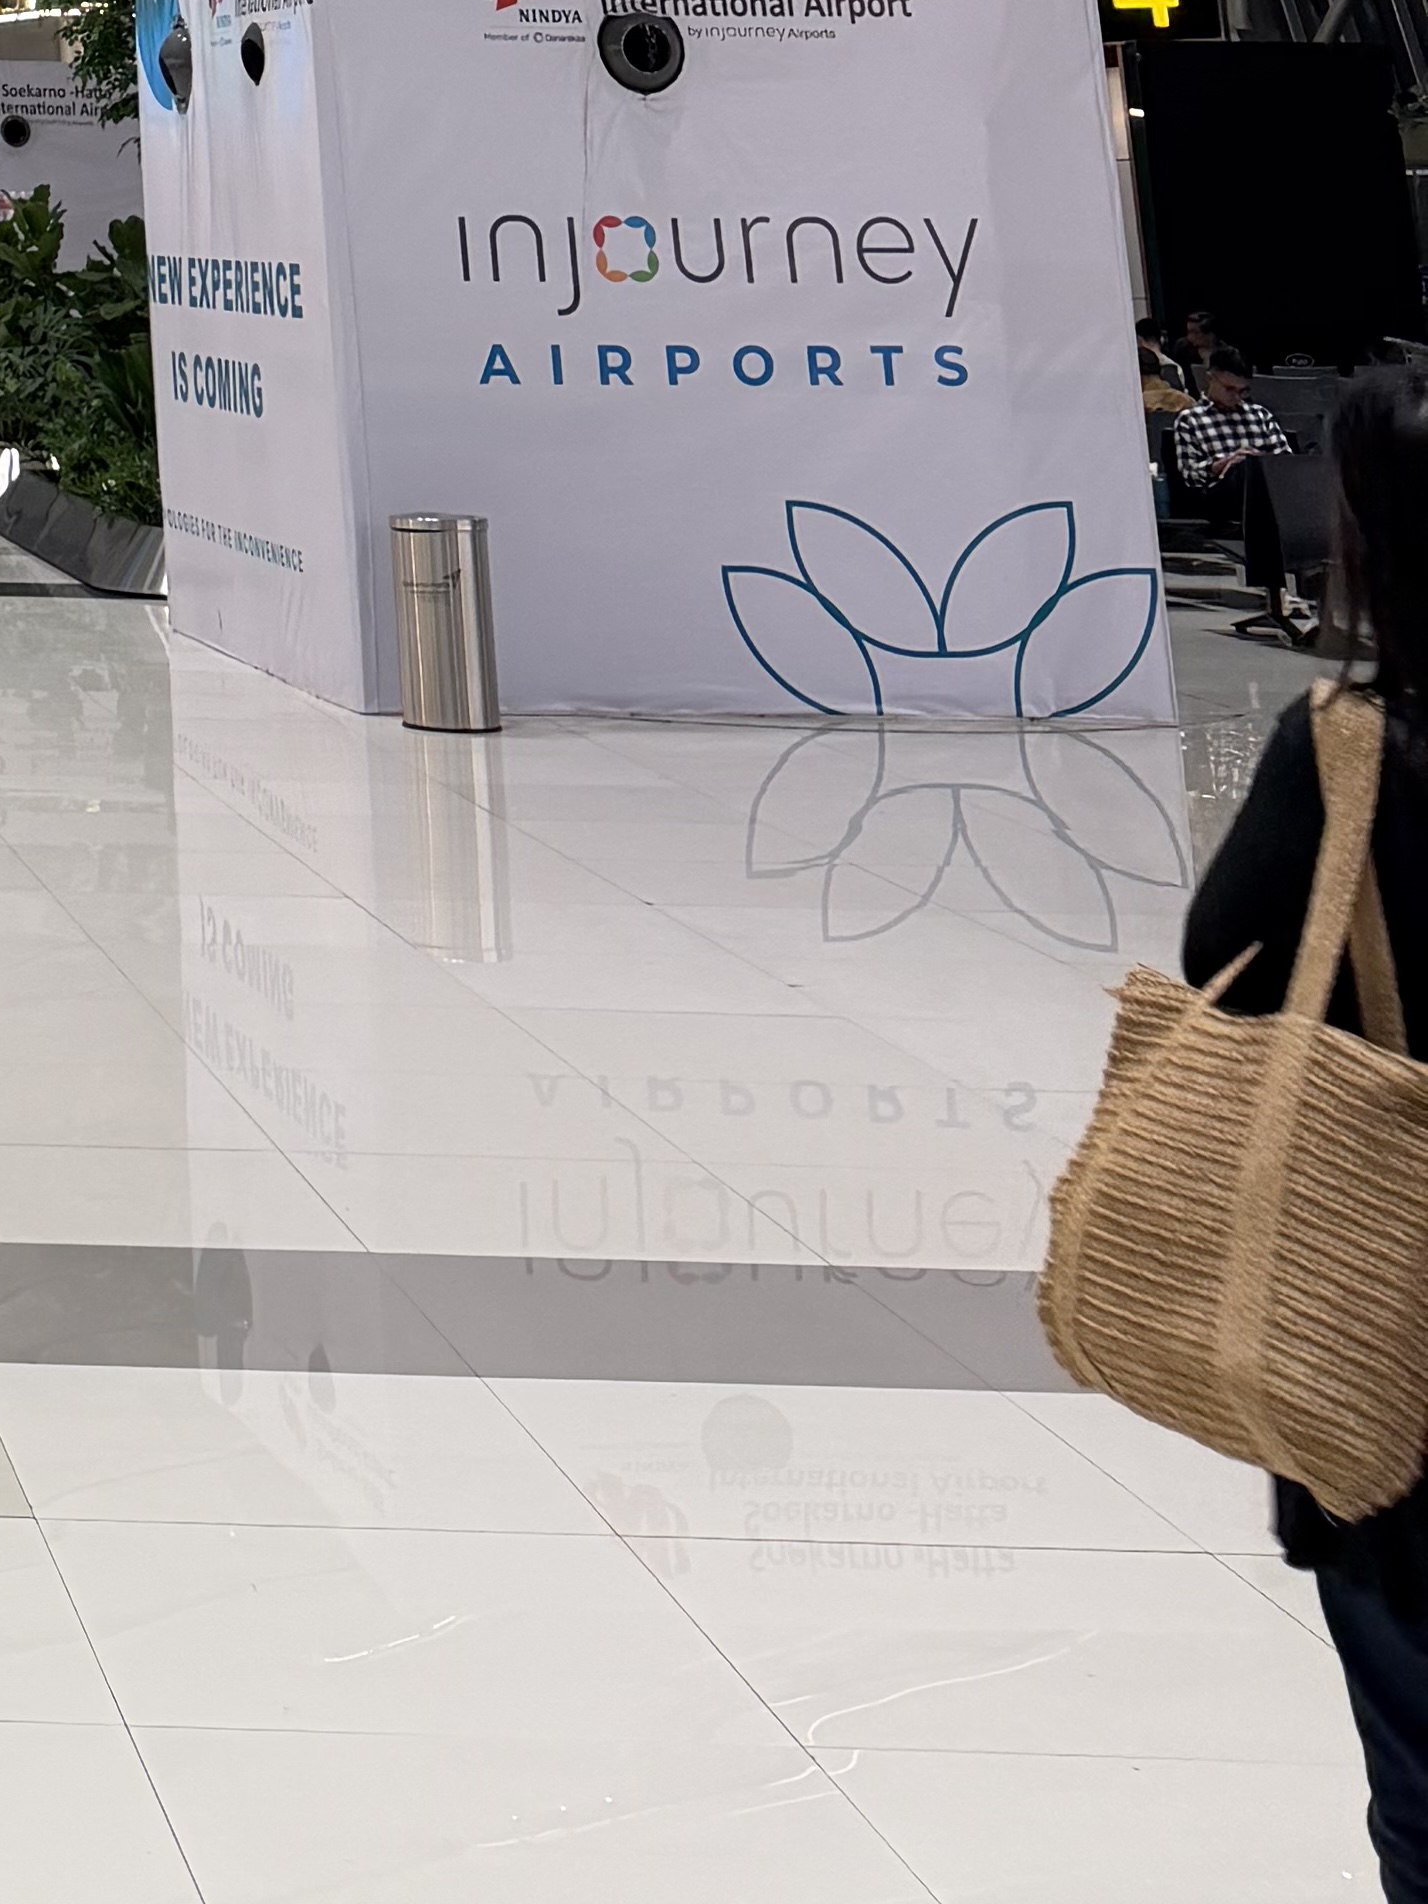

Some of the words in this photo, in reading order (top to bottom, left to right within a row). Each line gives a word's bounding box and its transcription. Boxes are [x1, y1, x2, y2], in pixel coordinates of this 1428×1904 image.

[483, 32, 519, 42] Member
[520, 33, 530, 42] of
[518, 8, 583, 24] NINDYA
[687, 25, 702, 39] by
[787, 27, 836, 41] Airports
[1, 83, 67, 99] Soekarno
[148, 254, 183, 306] NEW
[188, 256, 304, 319] EXPERIENCE
[457, 213, 979, 318] injourney
[171, 350, 189, 403] IS
[193, 353, 264, 419] COMING
[478, 343, 970, 387] AIRPORTS
[165, 508, 201, 538] OLOGIES
[201, 518, 217, 543] FOR
[217, 524, 233, 549] THE
[233, 530, 305, 573] INCONVENIENCE
